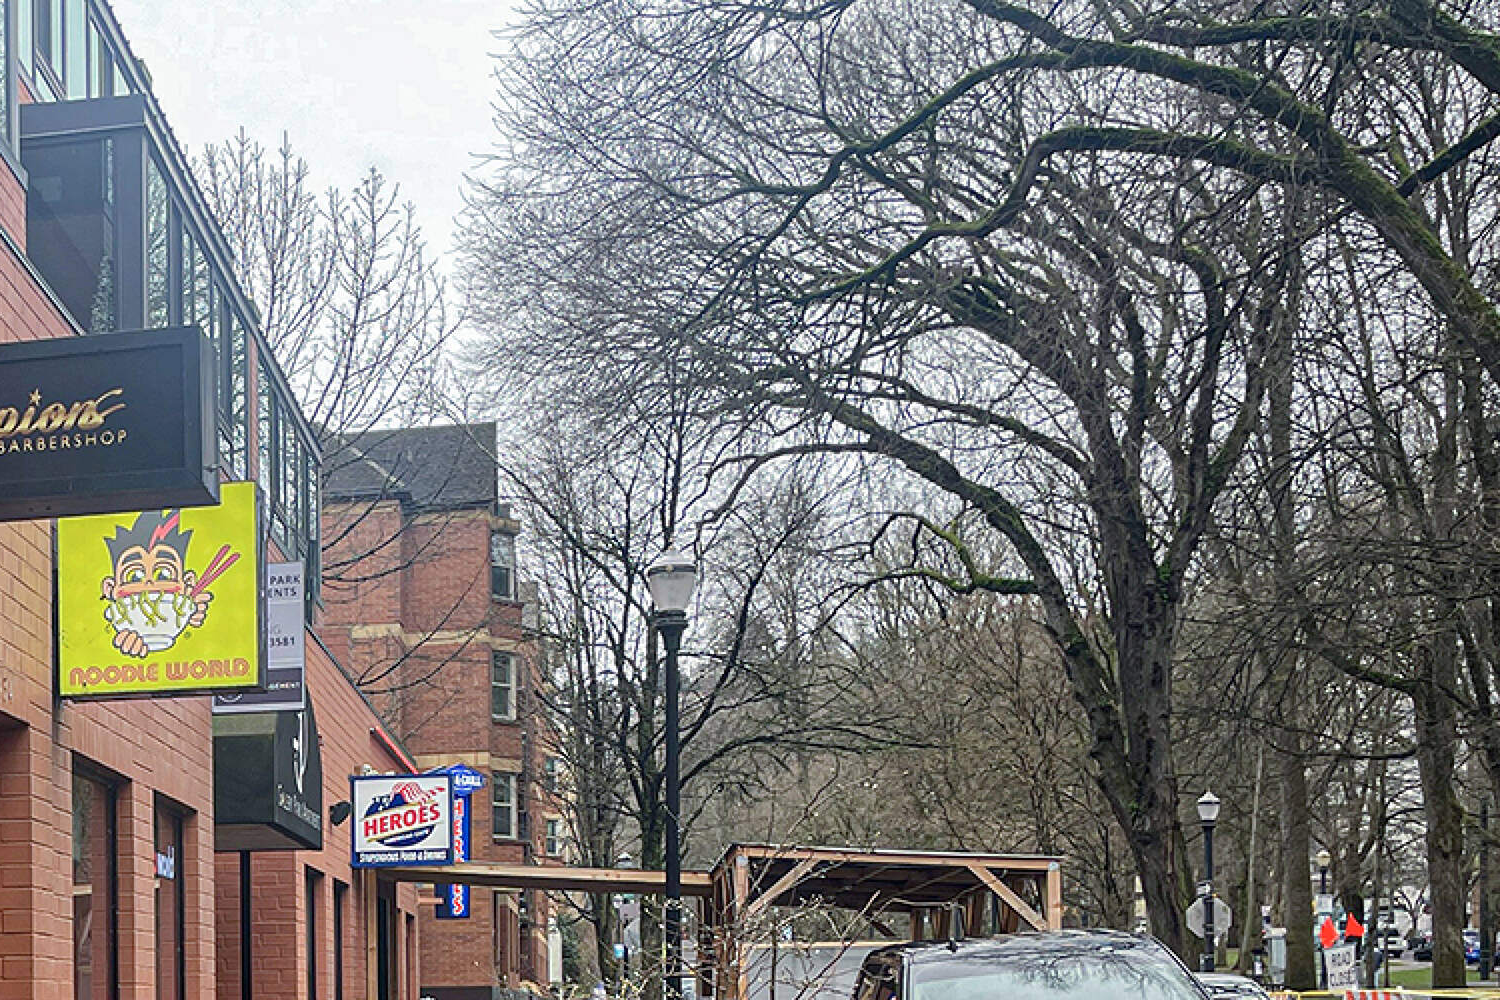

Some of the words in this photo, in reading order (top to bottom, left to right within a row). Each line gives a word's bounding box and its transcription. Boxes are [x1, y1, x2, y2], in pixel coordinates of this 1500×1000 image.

[269, 574, 301, 586] PARK
[69, 663, 159, 687] NOODLE
[165, 657, 250, 682] WORLD
[363, 803, 441, 837] HEROES
